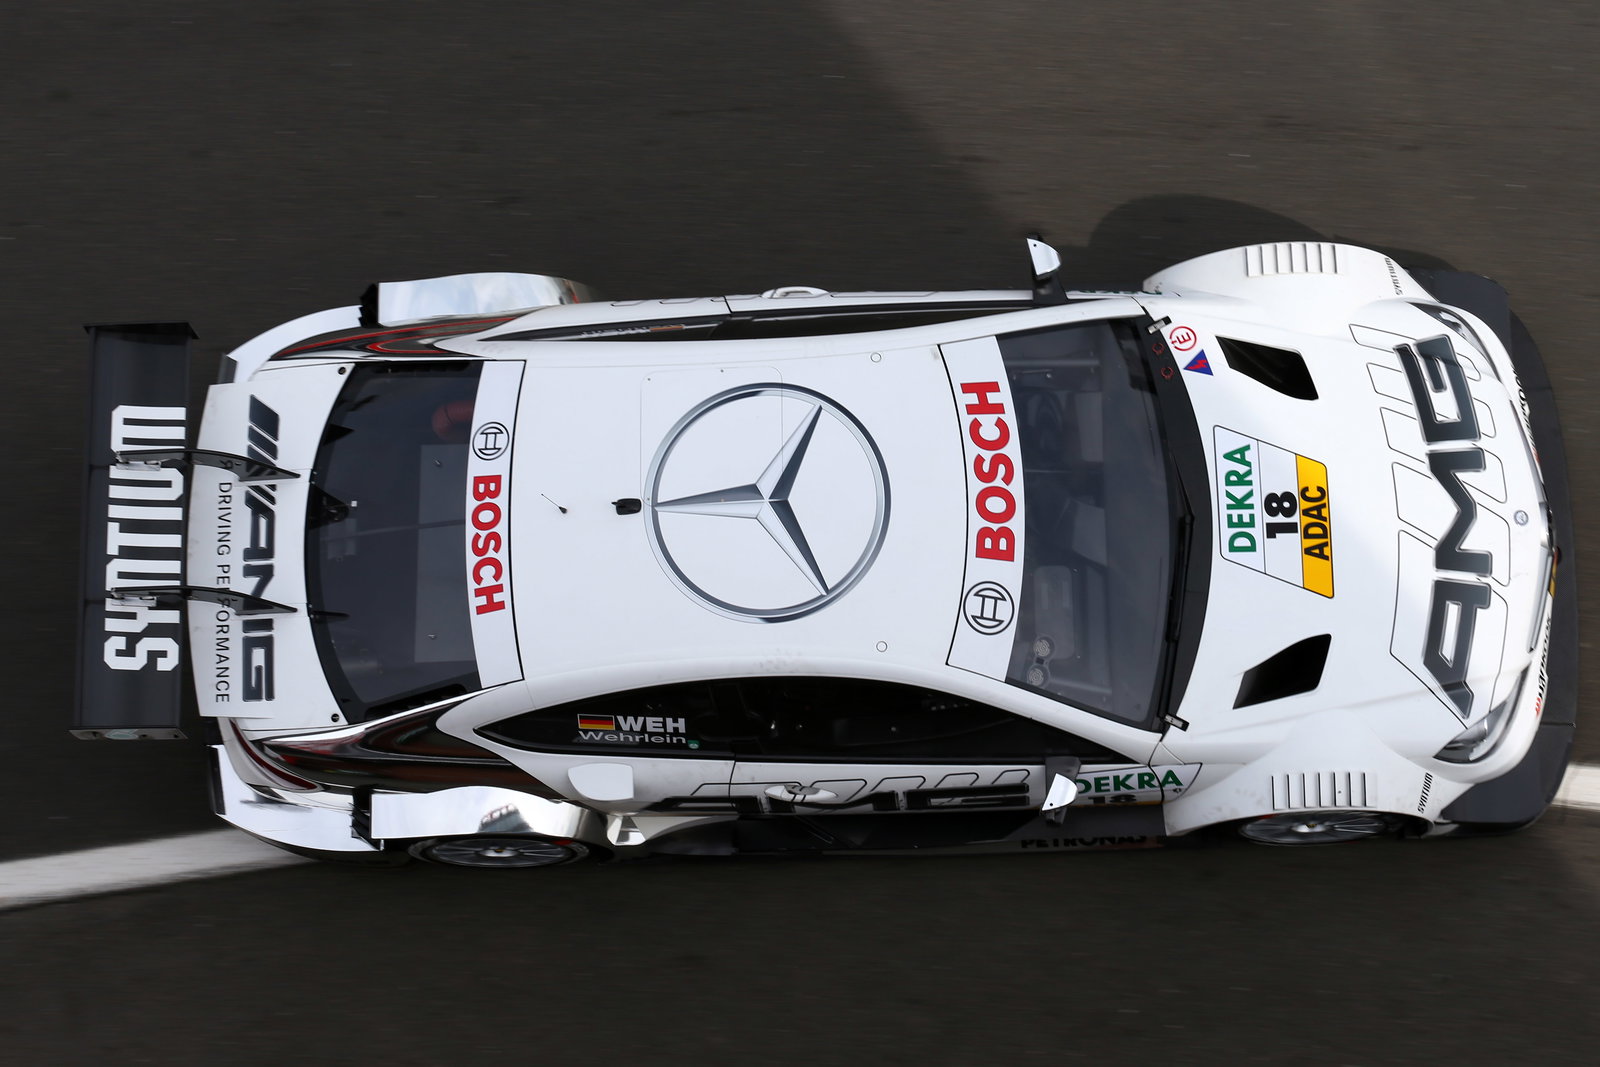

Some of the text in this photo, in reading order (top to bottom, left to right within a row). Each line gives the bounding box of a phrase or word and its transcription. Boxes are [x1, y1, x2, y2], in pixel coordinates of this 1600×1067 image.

[960, 381, 1016, 562] BOSCH
[1223, 444, 1257, 553] DEKRA
[1264, 491, 1299, 540] 18
[104, 404, 187, 672] SYNTIUM
[471, 474, 506, 615] BOSCH
[1300, 485, 1330, 561] ADAC
[1394, 333, 1492, 719] AMG
[215, 481, 232, 703] DRIVING PEORMANCE
[578, 730, 687, 744] Wehrlein
[616, 715, 686, 733] WEH
[1074, 769, 1184, 795] DEKRA
[1417, 772, 1434, 814] SYNTIUM
